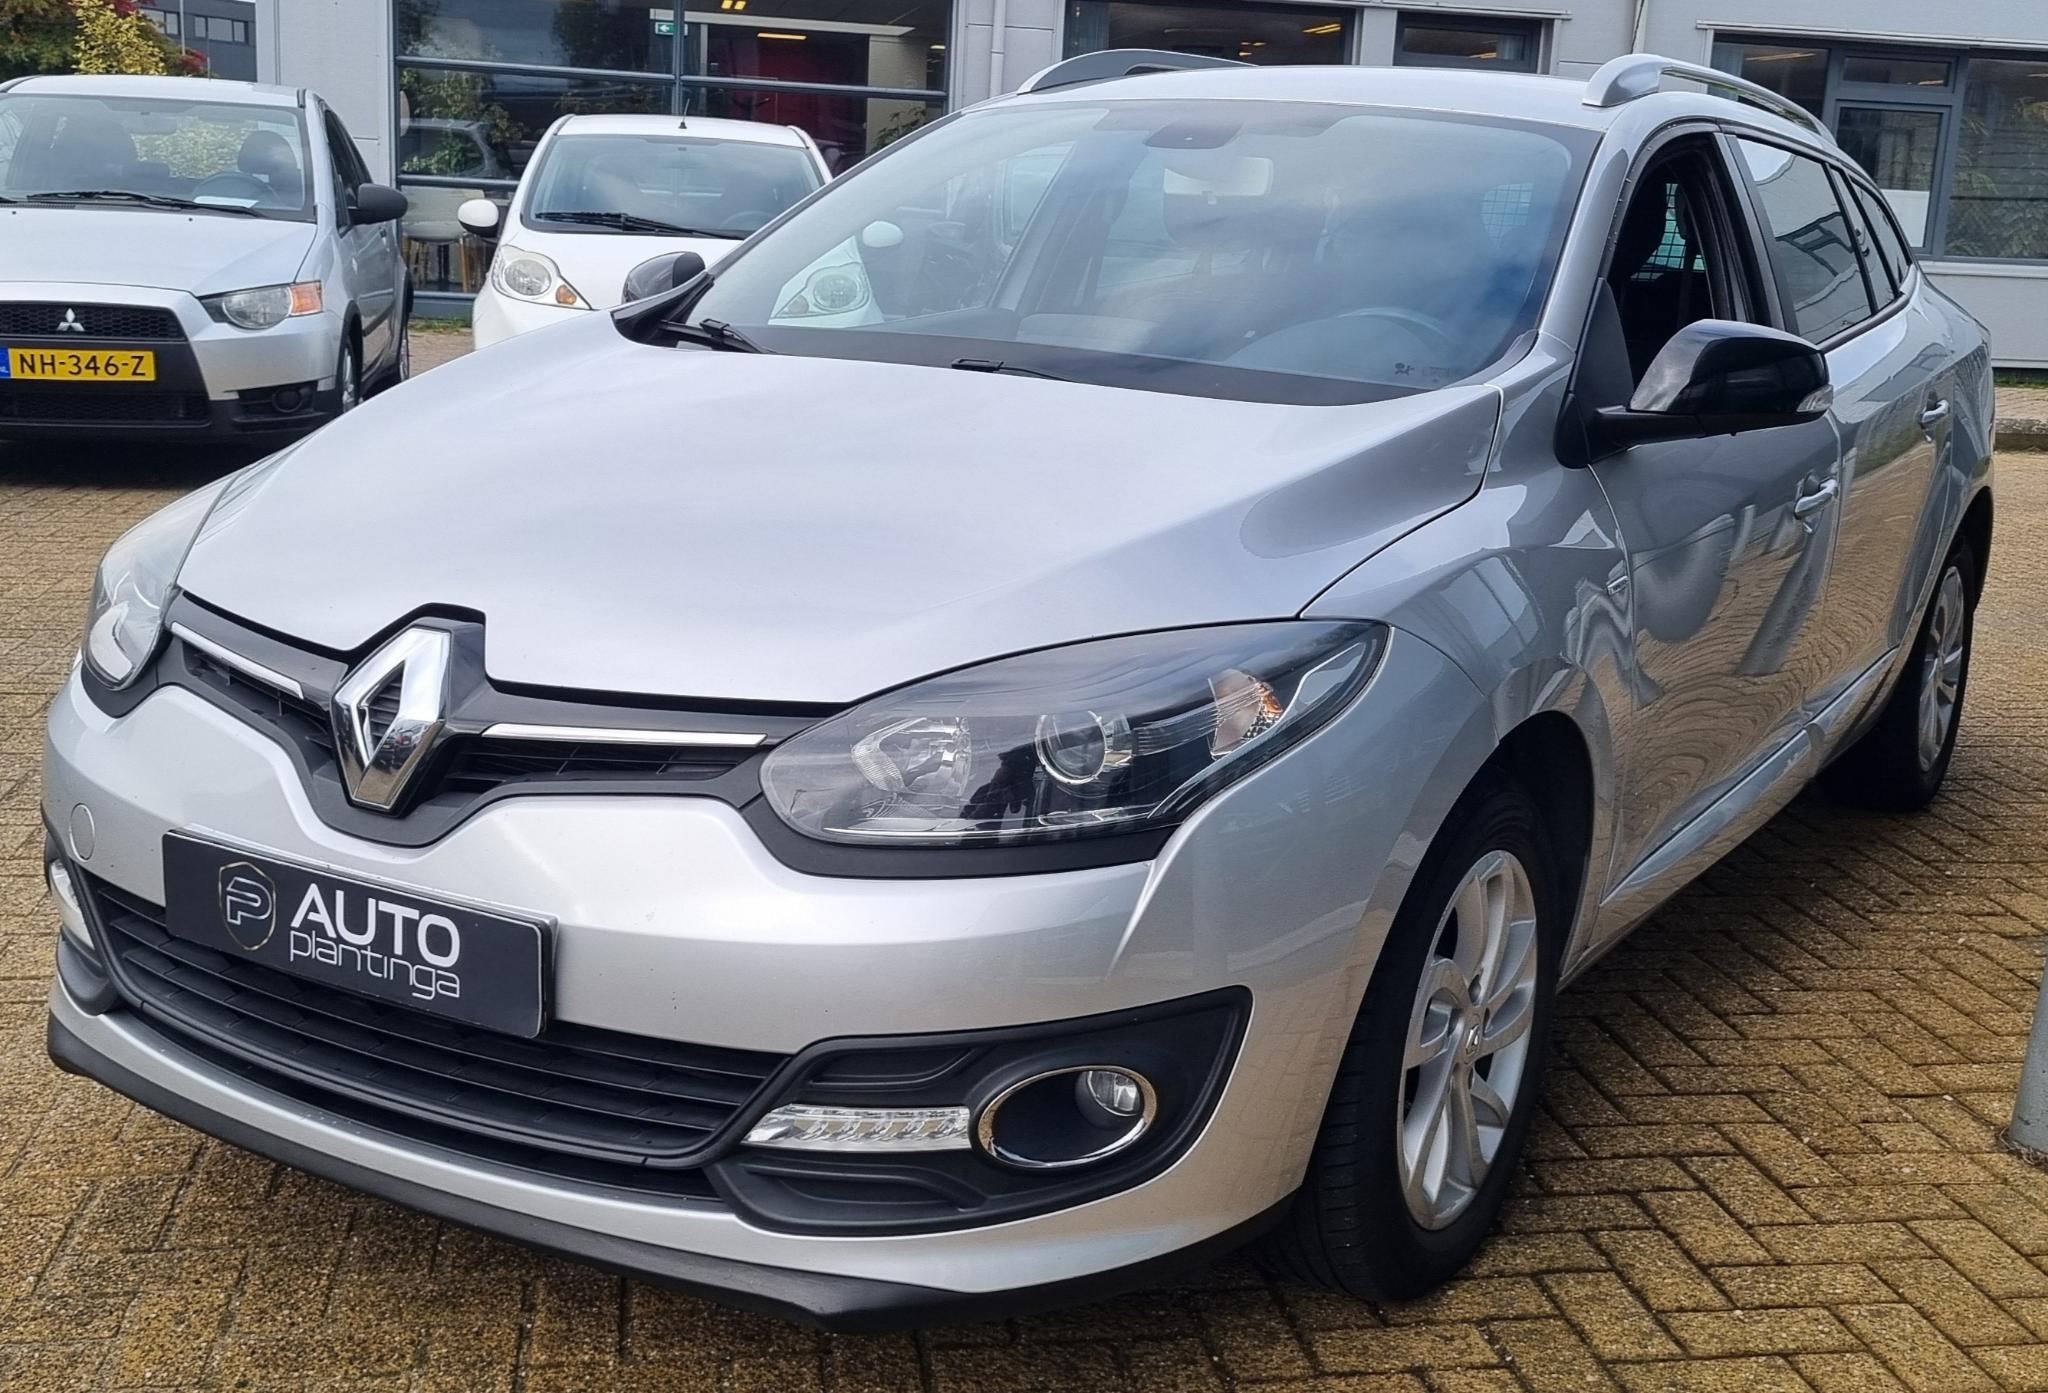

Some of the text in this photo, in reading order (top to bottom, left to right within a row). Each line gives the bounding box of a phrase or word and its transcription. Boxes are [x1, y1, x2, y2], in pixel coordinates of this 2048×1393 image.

[19, 353, 146, 377] NH-346-Z
[290, 883, 461, 968] AUTO
[290, 930, 461, 1000] plantinga
